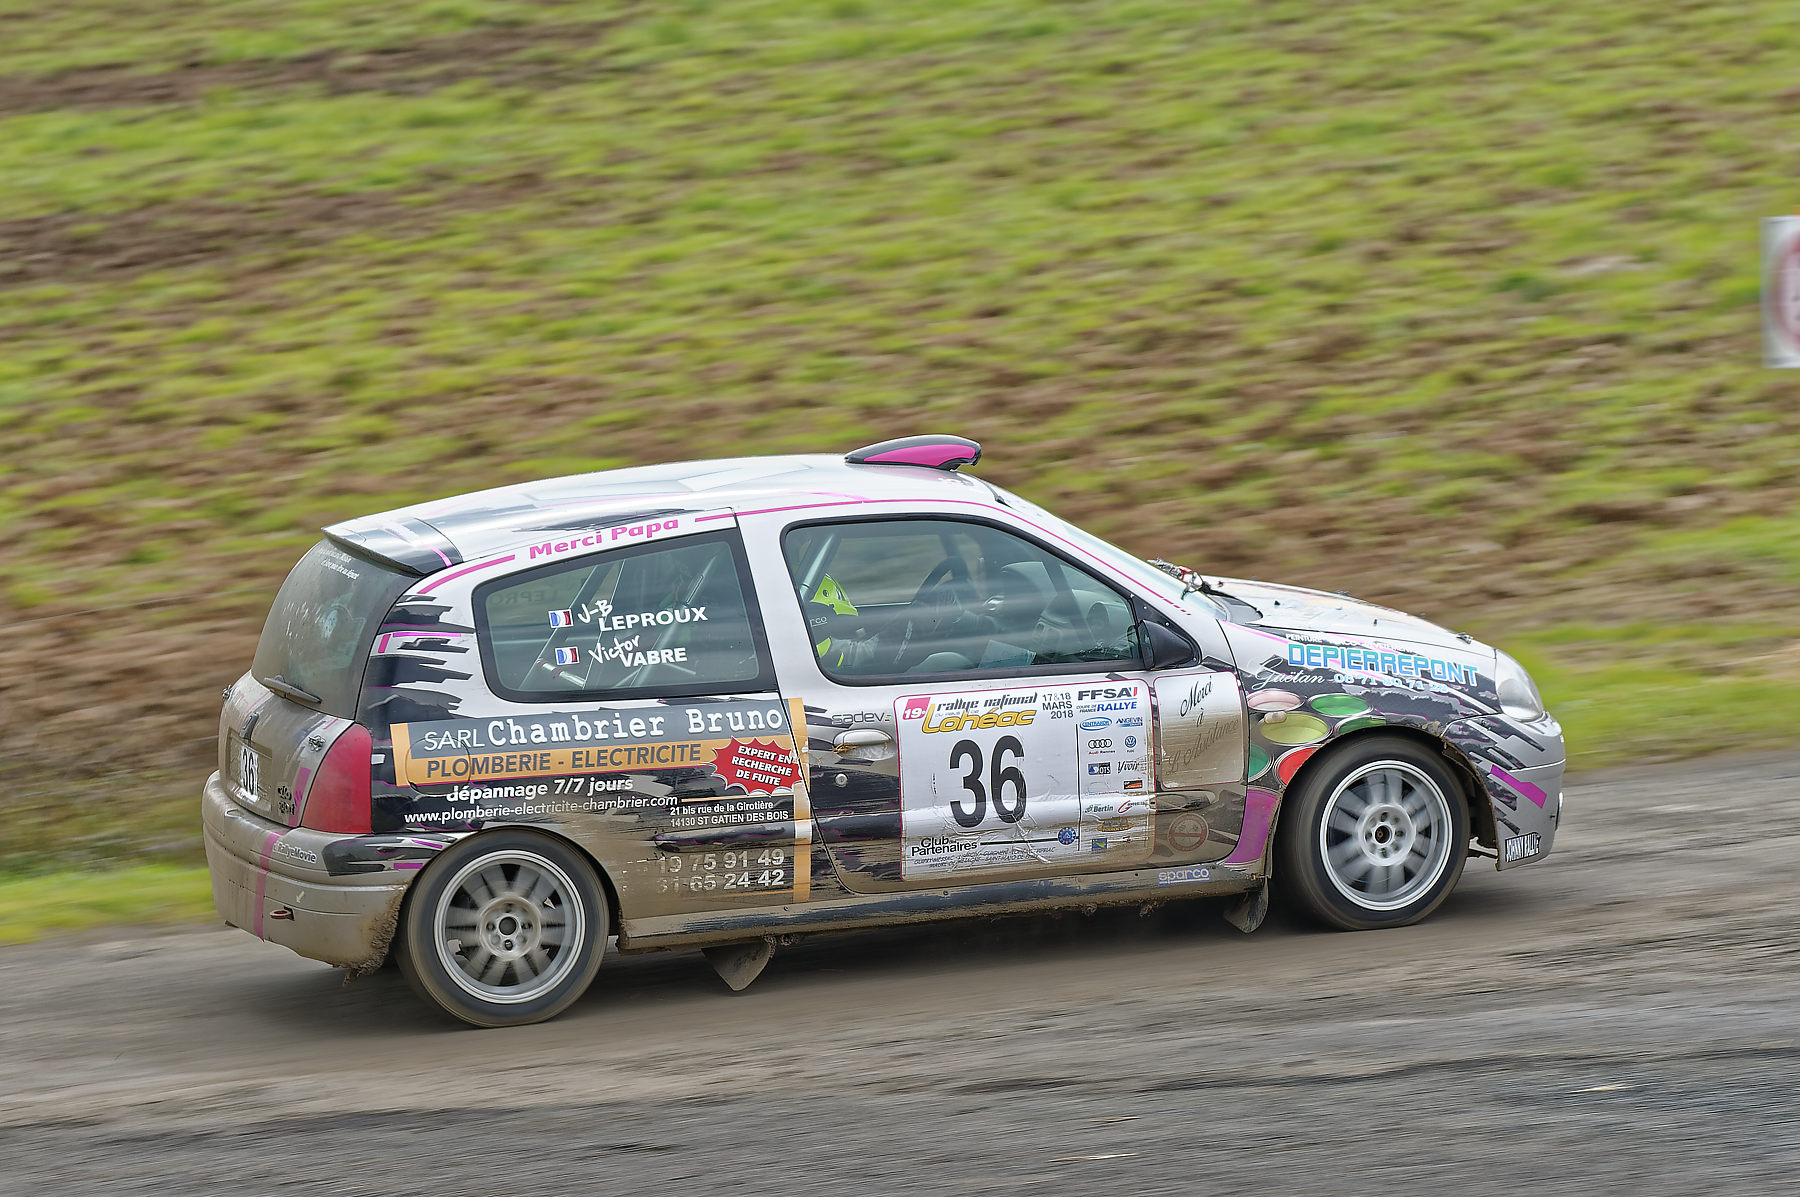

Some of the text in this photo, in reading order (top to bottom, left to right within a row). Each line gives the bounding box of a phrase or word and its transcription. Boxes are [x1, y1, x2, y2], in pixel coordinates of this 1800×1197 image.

[529, 519, 679, 560] Merci Papa
[577, 599, 613, 624] J-B
[598, 606, 708, 632] LEPROUX
[588, 635, 640, 664] Victor
[619, 647, 688, 668] VABRE
[1249, 655, 1325, 690] Gaëtan
[1287, 642, 1479, 687] DEPIERREPONT
[1078, 687, 1132, 701] FFSA
[1407, 678, 1424, 690] 71
[937, 692, 1038, 712] rallye national
[1042, 701, 1073, 711] MARS
[1097, 701, 1138, 712] RALLYE
[1180, 675, 1212, 717] Merci
[832, 711, 885, 724] sadev
[922, 703, 1037, 733] Lohéac
[1050, 709, 1074, 719] 2018
[1196, 707, 1204, 727] à
[424, 708, 783, 751] SARL Chambrier Bruno
[427, 753, 551, 778] PLOMBERIE
[571, 743, 702, 769] ELECTRICITE
[738, 745, 793, 764] EXPERT EN
[242, 748, 255, 796] 36
[731, 756, 792, 777] RECHERCHE
[736, 769, 781, 786] DE FUITE
[949, 735, 1027, 828] 36
[446, 776, 633, 803] dépannage 7/7 jours
[404, 795, 678, 824] www.plomberie-electricite-chambrier.com
[670, 800, 774, 816] 21 bis rue de la Girotière
[1093, 804, 1113, 812] Bertin
[670, 811, 789, 827] 14130 ST GATIEN DES BOIS
[911, 842, 978, 856] Partenaires
[920, 836, 949, 848] Club
[689, 853, 717, 871] 75
[723, 850, 748, 869] 91
[757, 848, 785, 866] 49
[689, 874, 717, 892] 65
[723, 872, 750, 890] 24
[757, 869, 784, 887] 42
[1159, 868, 1209, 884] sparco
